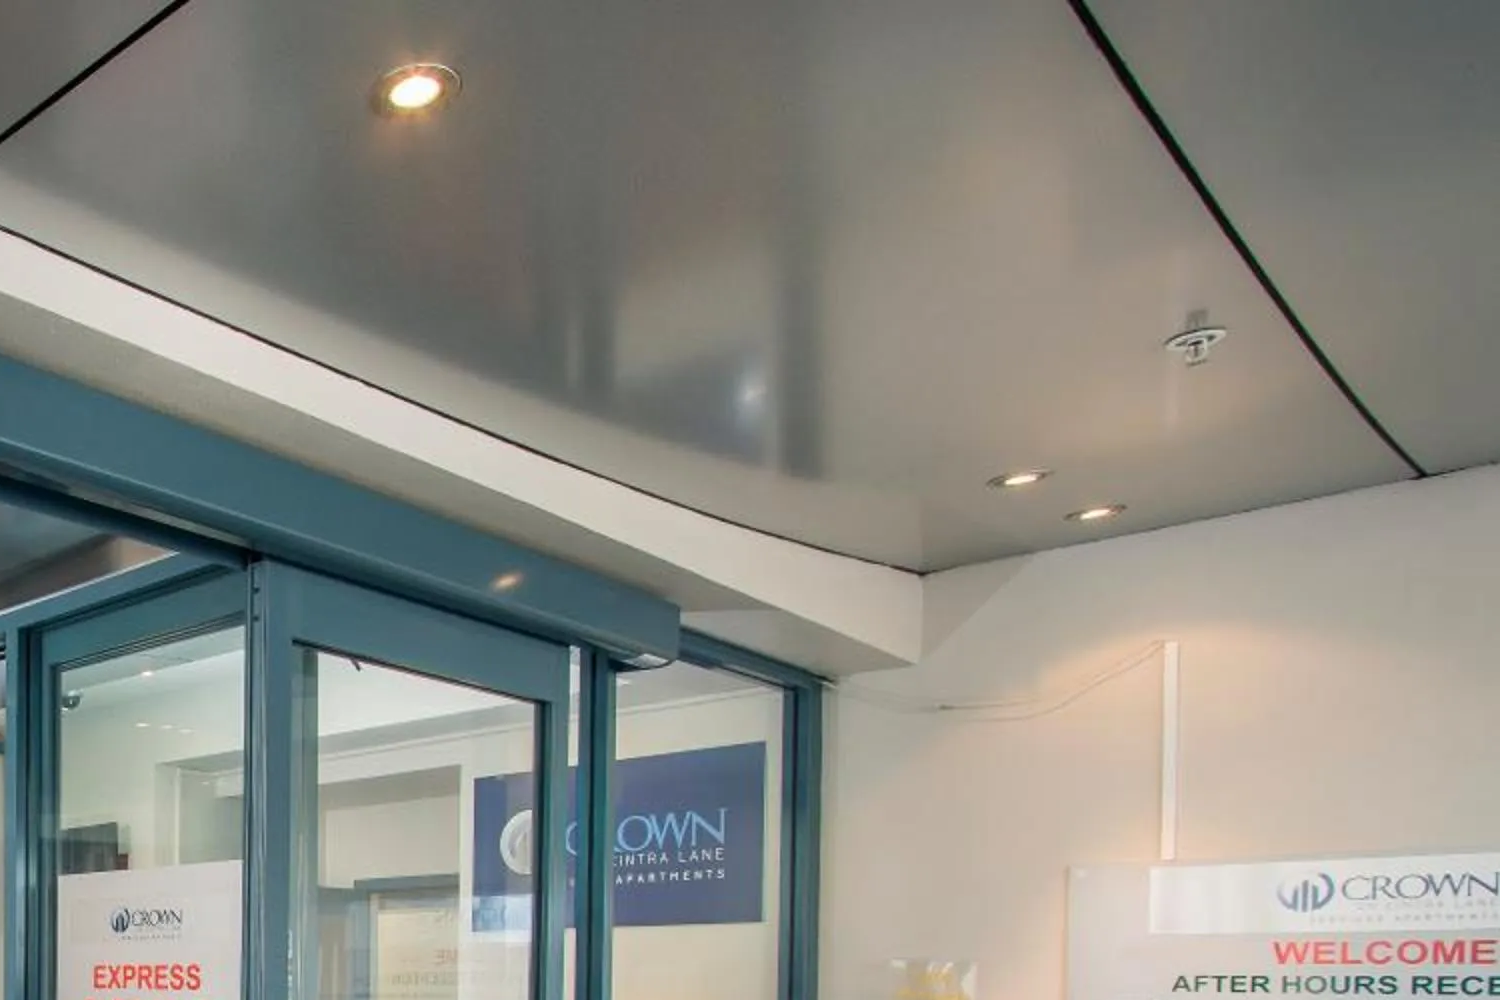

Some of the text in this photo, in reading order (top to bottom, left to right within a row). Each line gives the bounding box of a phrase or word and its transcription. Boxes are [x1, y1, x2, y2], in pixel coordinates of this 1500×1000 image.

[678, 847, 726, 863] LANE
[614, 868, 726, 885] APARTMENTS
[1341, 871, 1500, 901] CROWN
[131, 907, 184, 927] CROWN
[1273, 939, 1498, 966] WELCOME
[93, 963, 202, 992] EXPRESS
[1171, 975, 1271, 993] AFTER
[1281, 975, 1398, 996] HOURS
